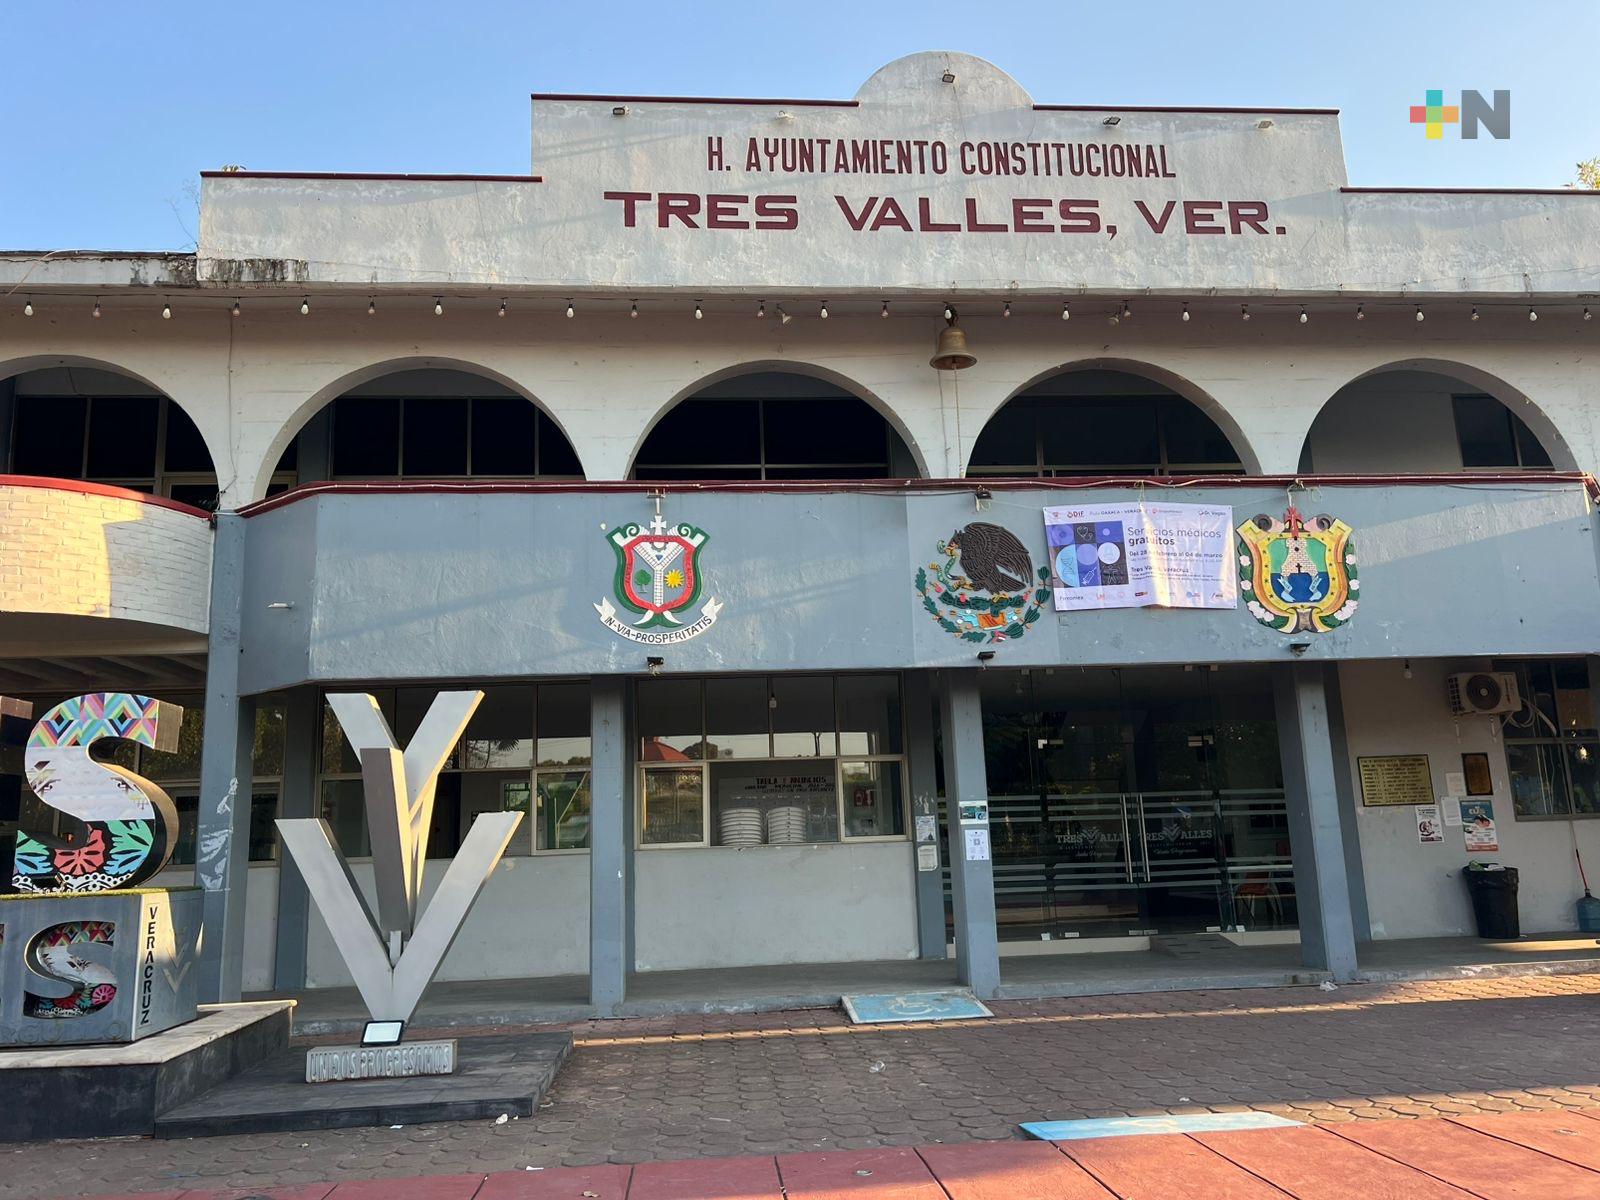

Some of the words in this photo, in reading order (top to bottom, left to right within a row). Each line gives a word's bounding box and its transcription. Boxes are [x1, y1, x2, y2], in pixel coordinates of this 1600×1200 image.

[707, 136, 731, 171] H.
[745, 137, 948, 175] AYUNTAMIENTO
[959, 141, 1177, 178] CONSTITUCIONAL
[603, 191, 799, 230] TRES
[833, 195, 1118, 240] VALLES,
[1133, 200, 1287, 235] VER.
[1128, 527, 1174, 536] Sericios
[1177, 527, 1221, 538] médicos
[1129, 535, 1175, 547] gratuitos
[140, 906, 158, 1026] VERACRUZ
